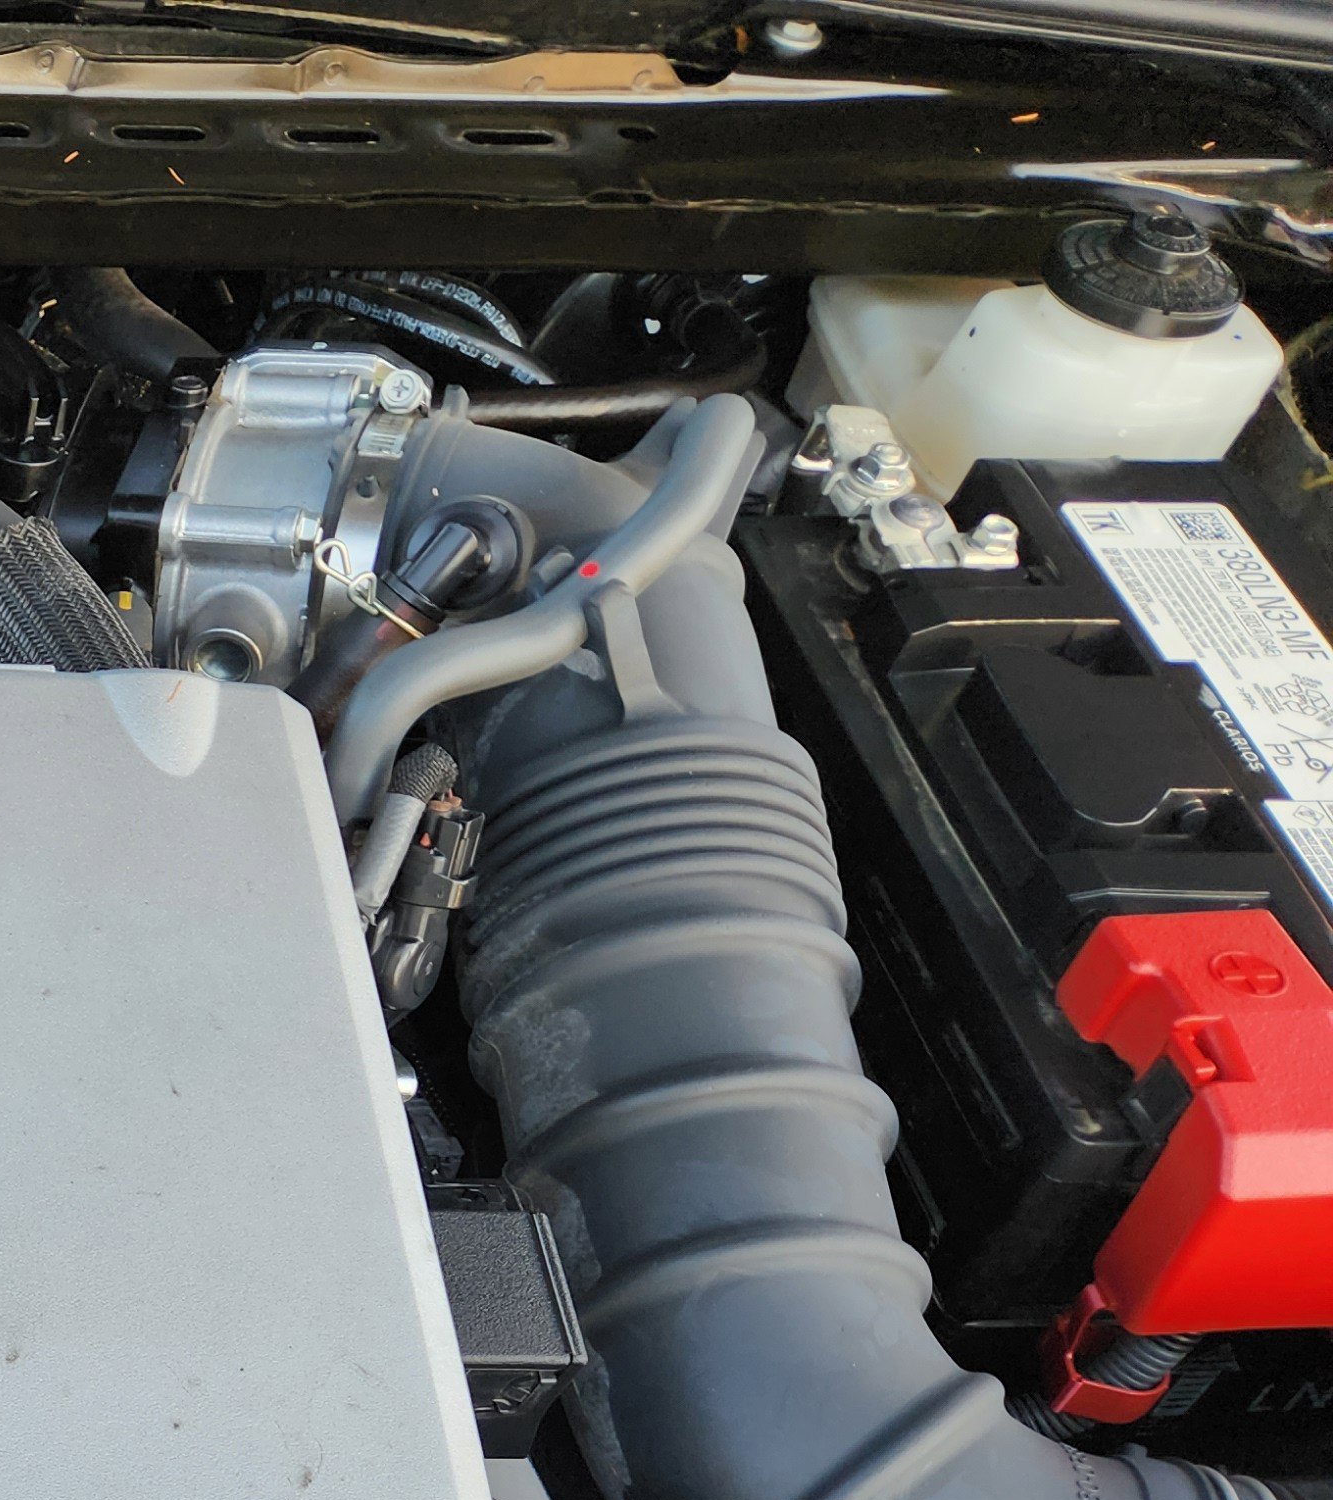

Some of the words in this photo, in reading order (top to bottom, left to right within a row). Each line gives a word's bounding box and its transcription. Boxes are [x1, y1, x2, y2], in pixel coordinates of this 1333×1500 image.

[1082, 511, 1126, 531] TK
[1218, 549, 1330, 661] 380LN3-MF
[1235, 687, 1261, 710] >PP<
[1213, 710, 1265, 773] CLARIOS
[1264, 742, 1293, 767] Pb
